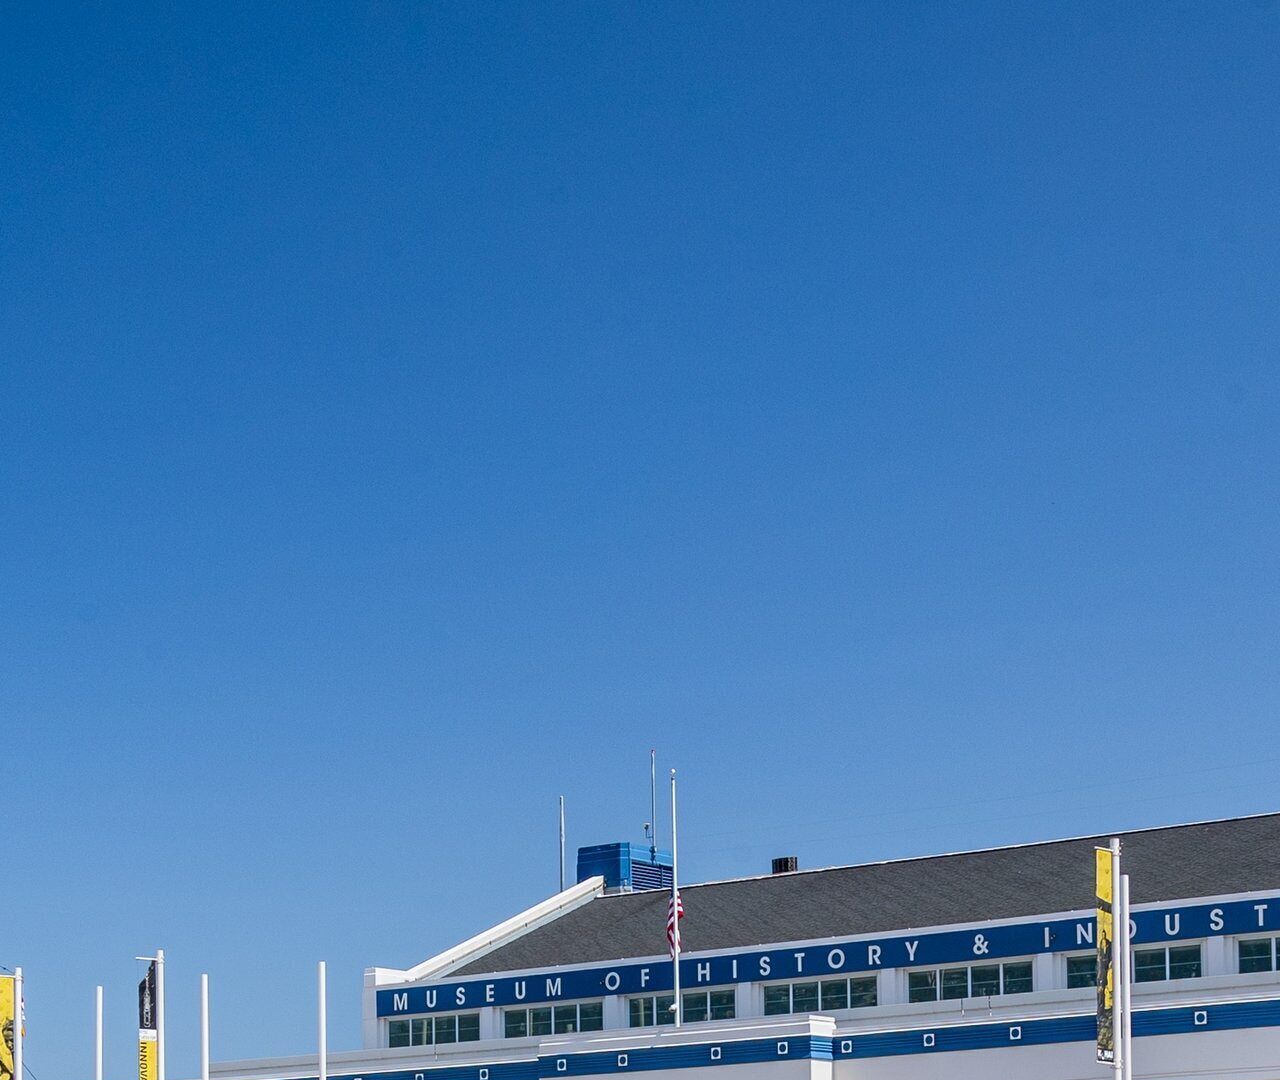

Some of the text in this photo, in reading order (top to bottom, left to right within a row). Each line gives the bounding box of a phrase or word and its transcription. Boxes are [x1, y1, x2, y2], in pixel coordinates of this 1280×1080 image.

[393, 977, 562, 1011] MUSEUM
[604, 968, 652, 991] OF
[697, 940, 918, 982] HISTORY
[972, 933, 989, 955] &
